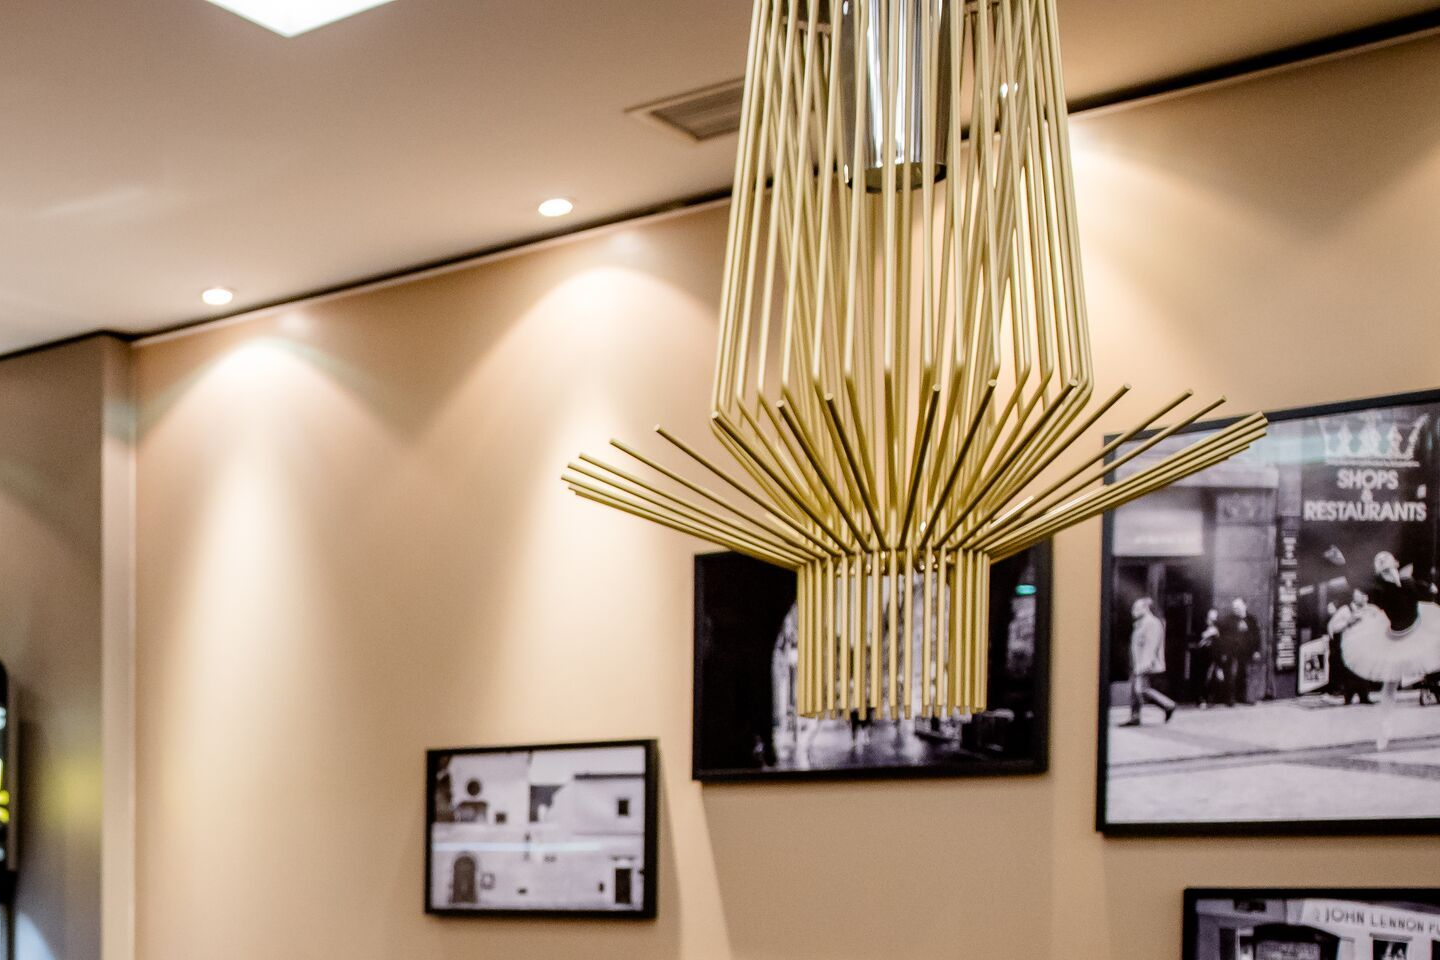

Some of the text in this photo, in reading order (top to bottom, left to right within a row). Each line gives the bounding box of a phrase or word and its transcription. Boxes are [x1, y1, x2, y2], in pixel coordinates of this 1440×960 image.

[1337, 468, 1398, 489] SHOPS
[1303, 500, 1427, 521] RESTAURANTS
[1325, 908, 1365, 923] JOHN
[1370, 914, 1424, 932] LENNON
